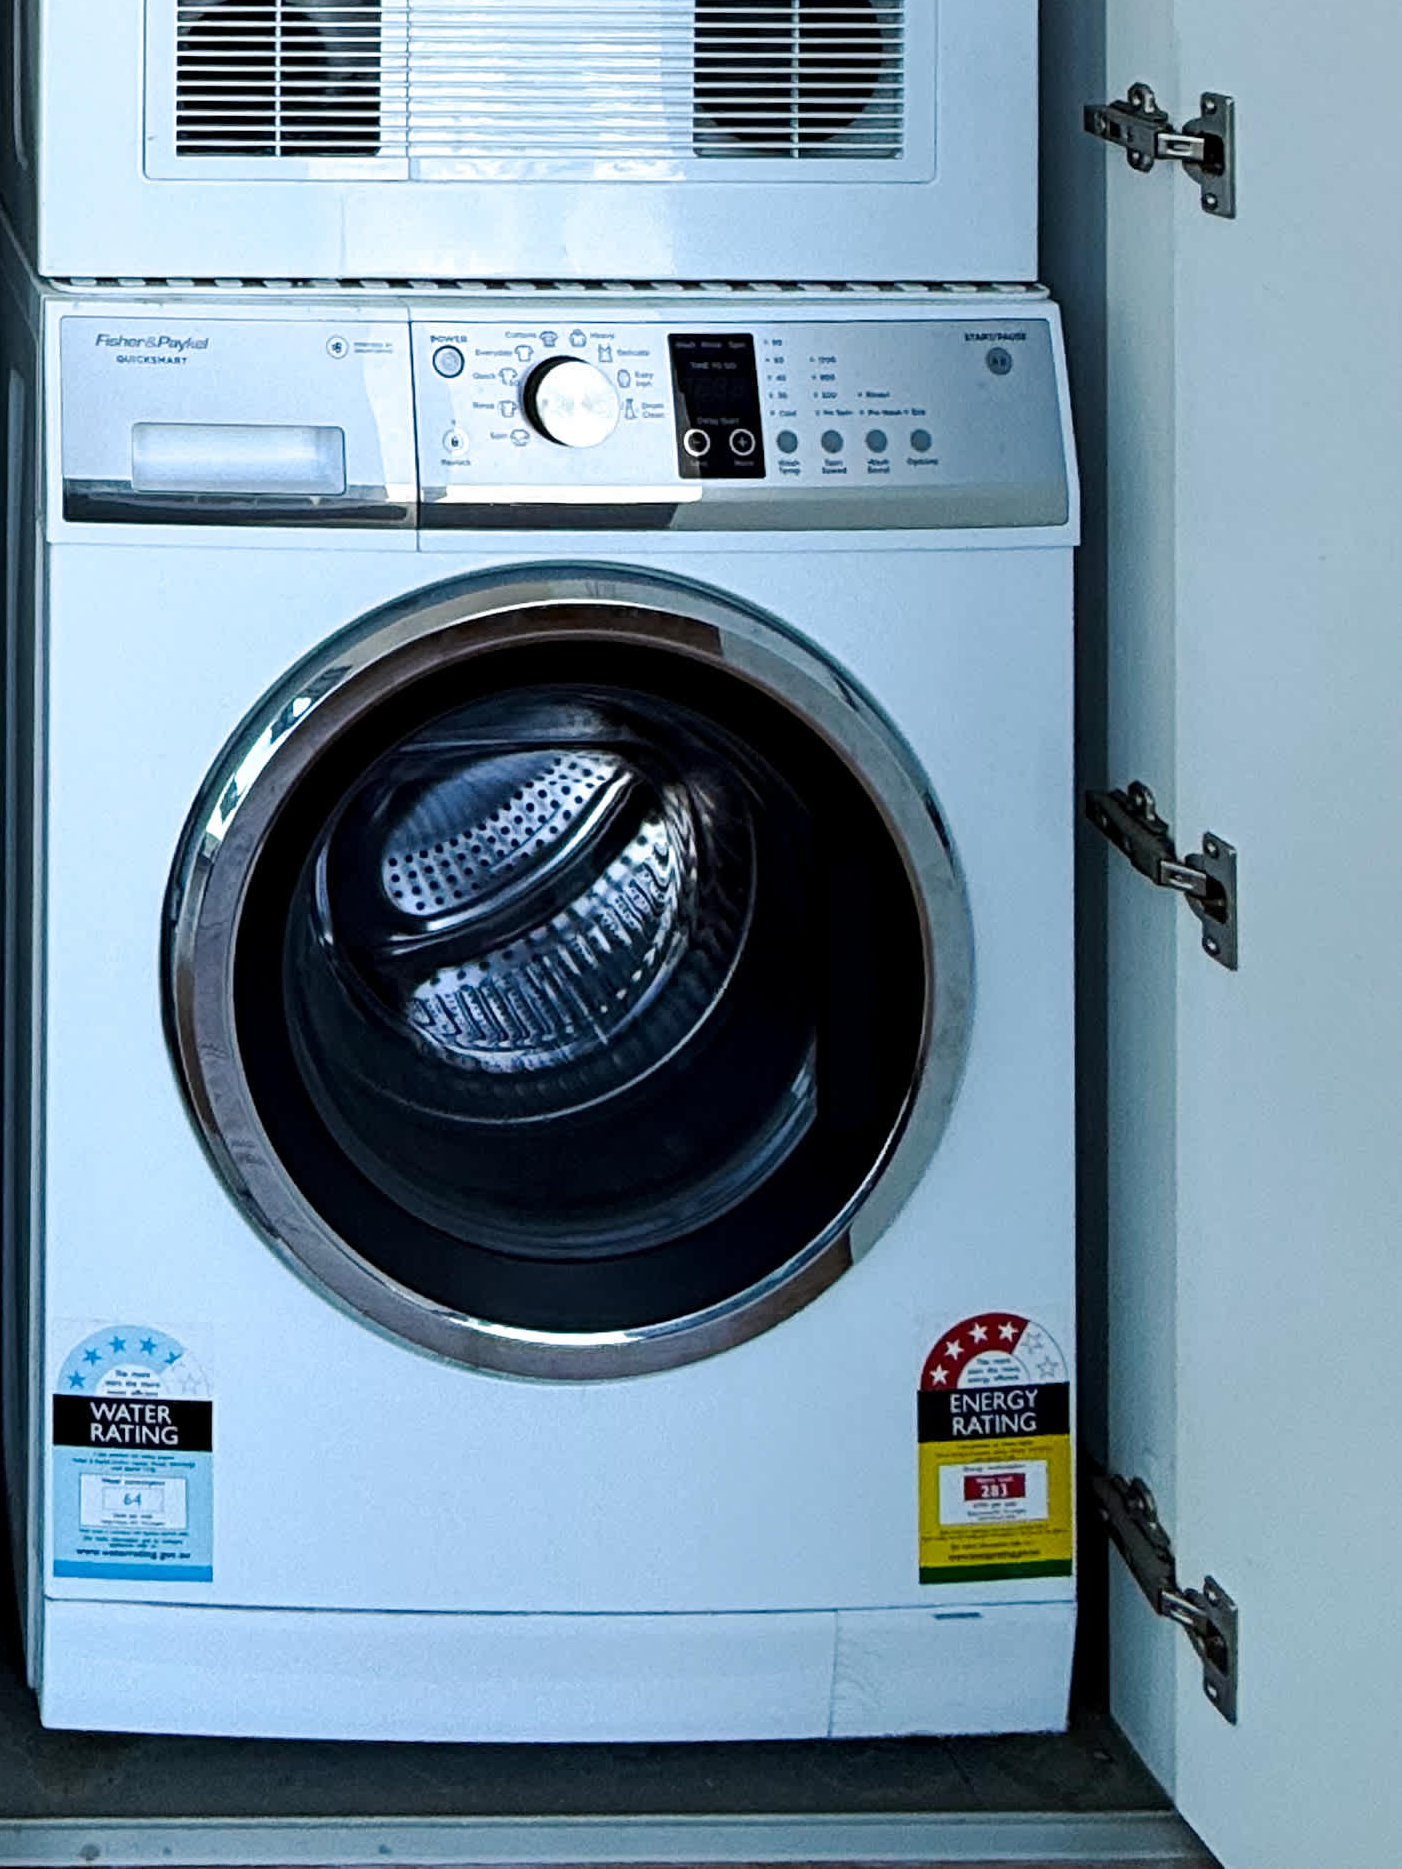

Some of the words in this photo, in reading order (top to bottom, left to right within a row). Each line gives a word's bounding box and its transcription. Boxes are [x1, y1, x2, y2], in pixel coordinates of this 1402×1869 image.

[430, 335, 468, 343] POWER
[116, 355, 187, 364] QUICKSMART
[950, 1388, 1038, 1414] ENERGY
[90, 1401, 172, 1425] WATER
[952, 1411, 1038, 1436] RATING
[90, 1422, 179, 1445] RATING
[123, 1493, 142, 1507] 64
